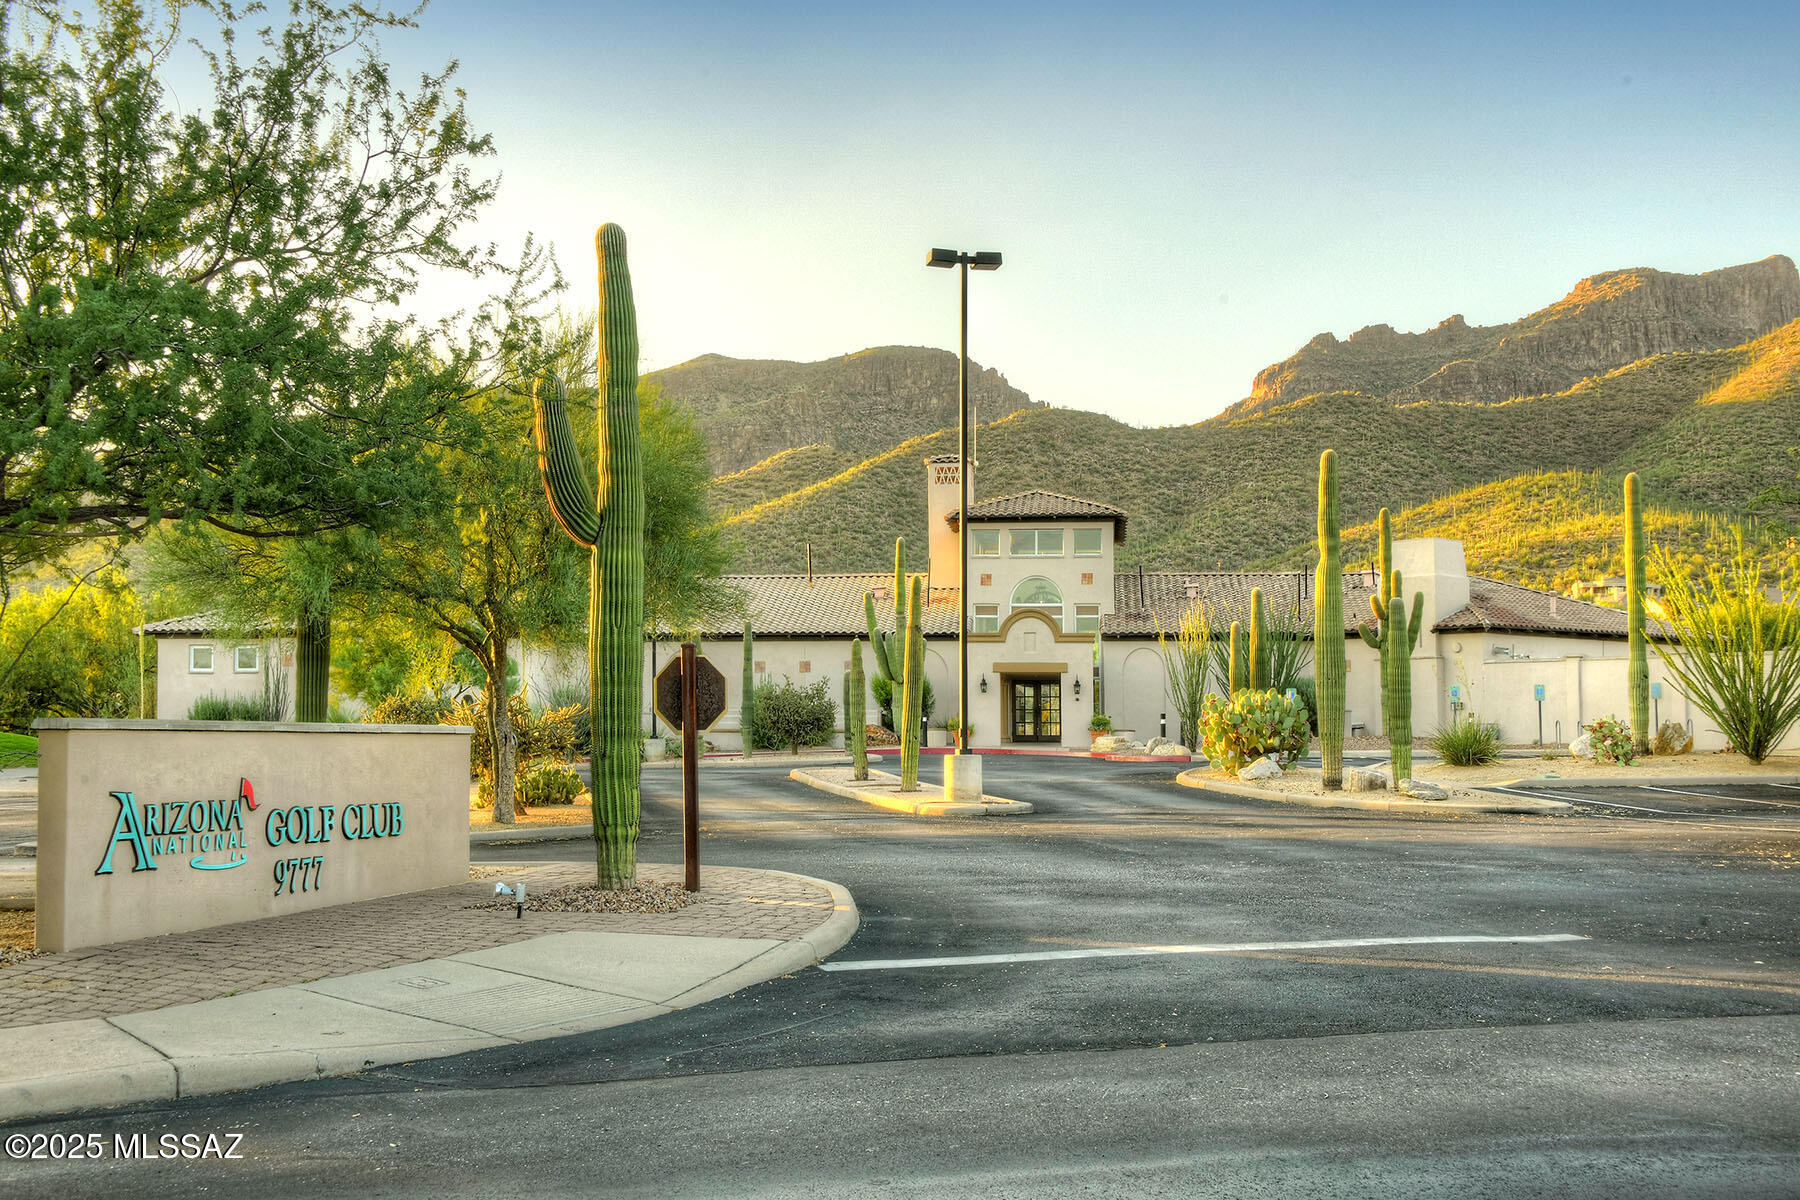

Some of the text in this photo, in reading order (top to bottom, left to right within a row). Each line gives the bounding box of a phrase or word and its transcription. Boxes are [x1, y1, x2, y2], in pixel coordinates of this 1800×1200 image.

[95, 791, 243, 875] ARIZONA
[152, 829, 248, 856] NATIONAL
[265, 802, 405, 846] GOLF CLUB
[274, 856, 325, 896] 9777
